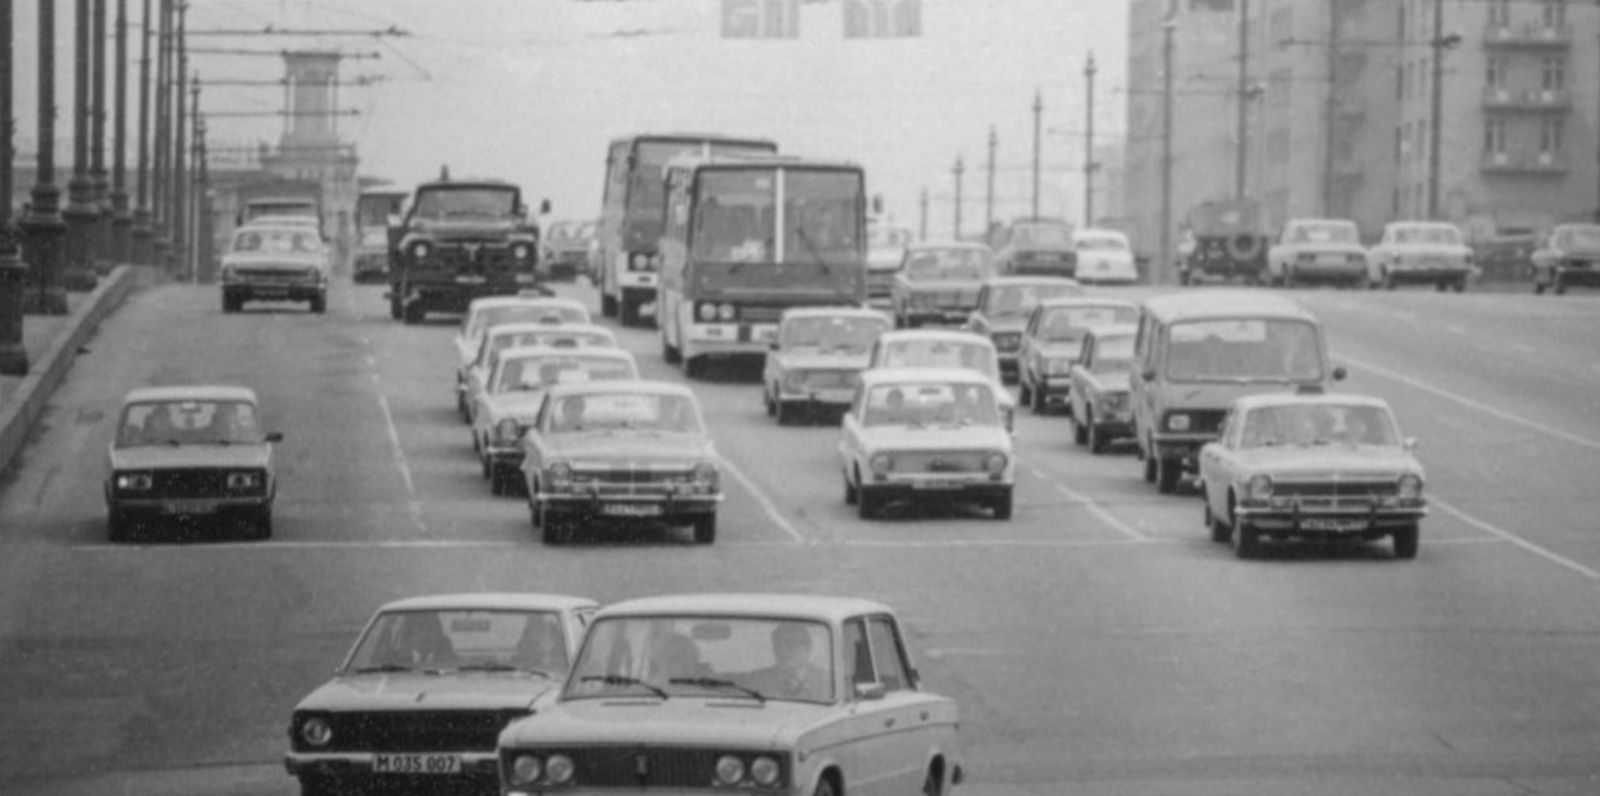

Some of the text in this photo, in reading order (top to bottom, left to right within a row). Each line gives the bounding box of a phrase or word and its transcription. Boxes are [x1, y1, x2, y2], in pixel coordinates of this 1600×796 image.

[377, 756, 455, 770] M 035 007
